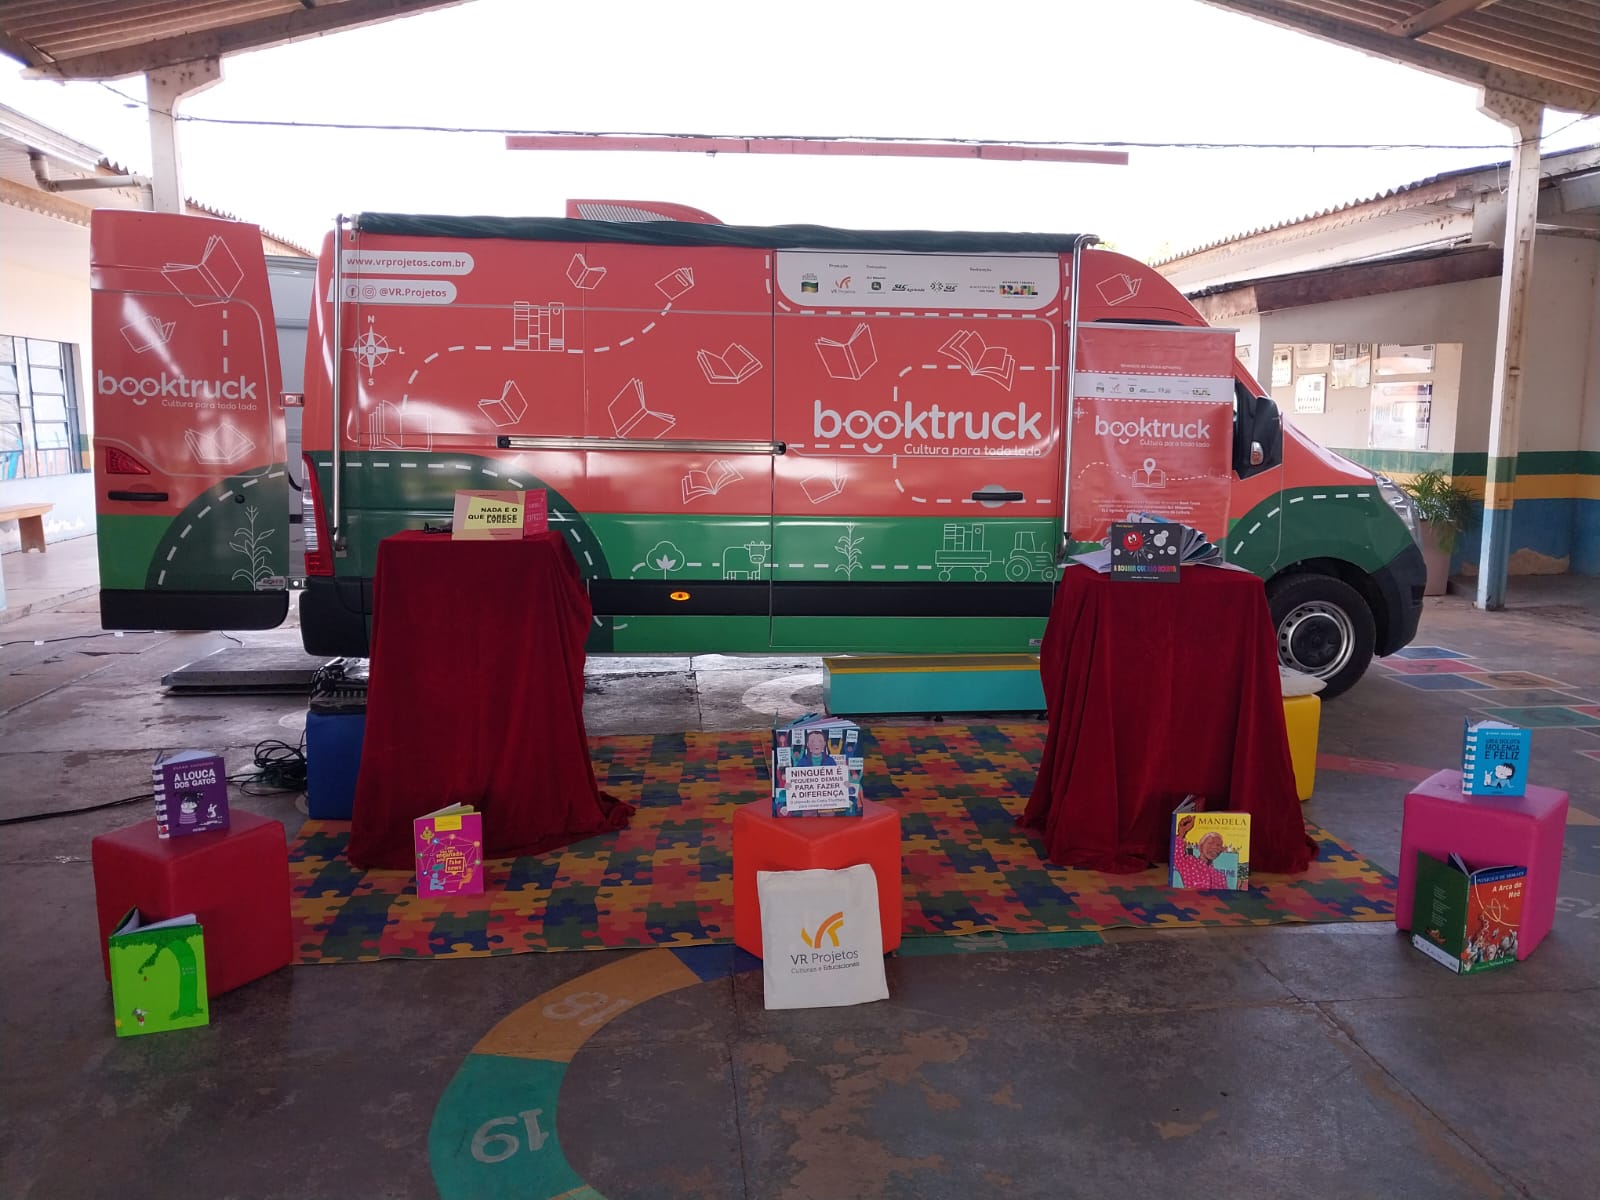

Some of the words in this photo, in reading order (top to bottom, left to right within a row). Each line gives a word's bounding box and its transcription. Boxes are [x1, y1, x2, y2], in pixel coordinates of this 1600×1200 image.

[346, 258, 466, 268] www.vrprojetos.com.br
[379, 287, 447, 299] @VR.Projetos
[367, 315, 375, 323] N
[97, 369, 257, 400] booktruck
[368, 378, 375, 386] S
[161, 399, 193, 408] Cultura
[194, 401, 216, 410] para
[813, 399, 1042, 440] booktruck
[1094, 415, 1210, 439] booktruck
[903, 443, 949, 455] Cultura
[952, 445, 982, 459] para
[984, 444, 1012, 456] todo
[1014, 445, 1041, 456] lado
[1485, 743, 1520, 751] MOLENGA
[1484, 751, 1491, 760] E
[1493, 751, 1520, 760] FELIZ
[174, 773, 182, 783] A
[183, 768, 216, 781] LOUCA
[791, 767, 834, 778] NINGUÉM
[836, 766, 843, 776] É
[174, 781, 190, 790] DOS
[191, 777, 217, 787] GATOS
[816, 782, 841, 790] FAZER
[799, 790, 844, 799] DIFERENÇA
[1198, 817, 1247, 826] MANDELA
[1498, 883, 1513, 892] Arca
[790, 954, 809, 965] VR
[811, 950, 859, 964] Projetos
[469, 1107, 550, 1164] 19
